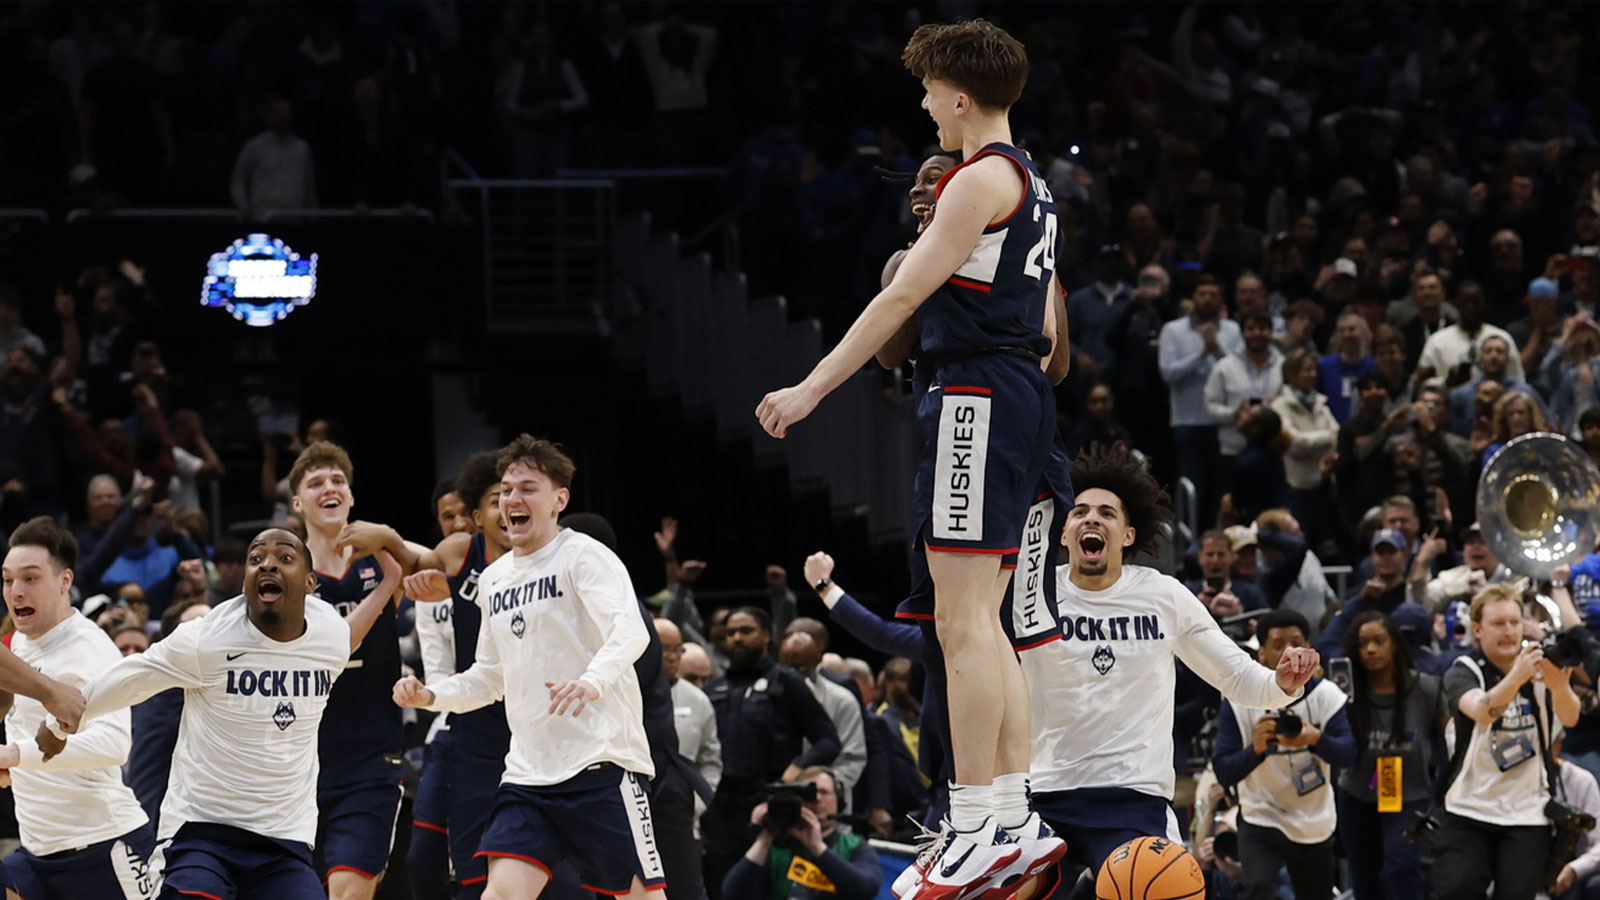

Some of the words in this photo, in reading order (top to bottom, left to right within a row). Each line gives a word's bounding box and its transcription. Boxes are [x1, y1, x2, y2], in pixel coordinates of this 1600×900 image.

[948, 405, 975, 532] HUSKIES
[522, 581, 537, 605] IT
[538, 574, 563, 600] IN.
[1024, 509, 1043, 629] HUSKIES
[1060, 616, 1106, 642] OCK
[1109, 616, 1129, 641] IT
[1134, 615, 1165, 640] IN.
[226, 670, 288, 697] LOCK
[293, 671, 310, 697] IT
[627, 771, 659, 872] HUSKIES
